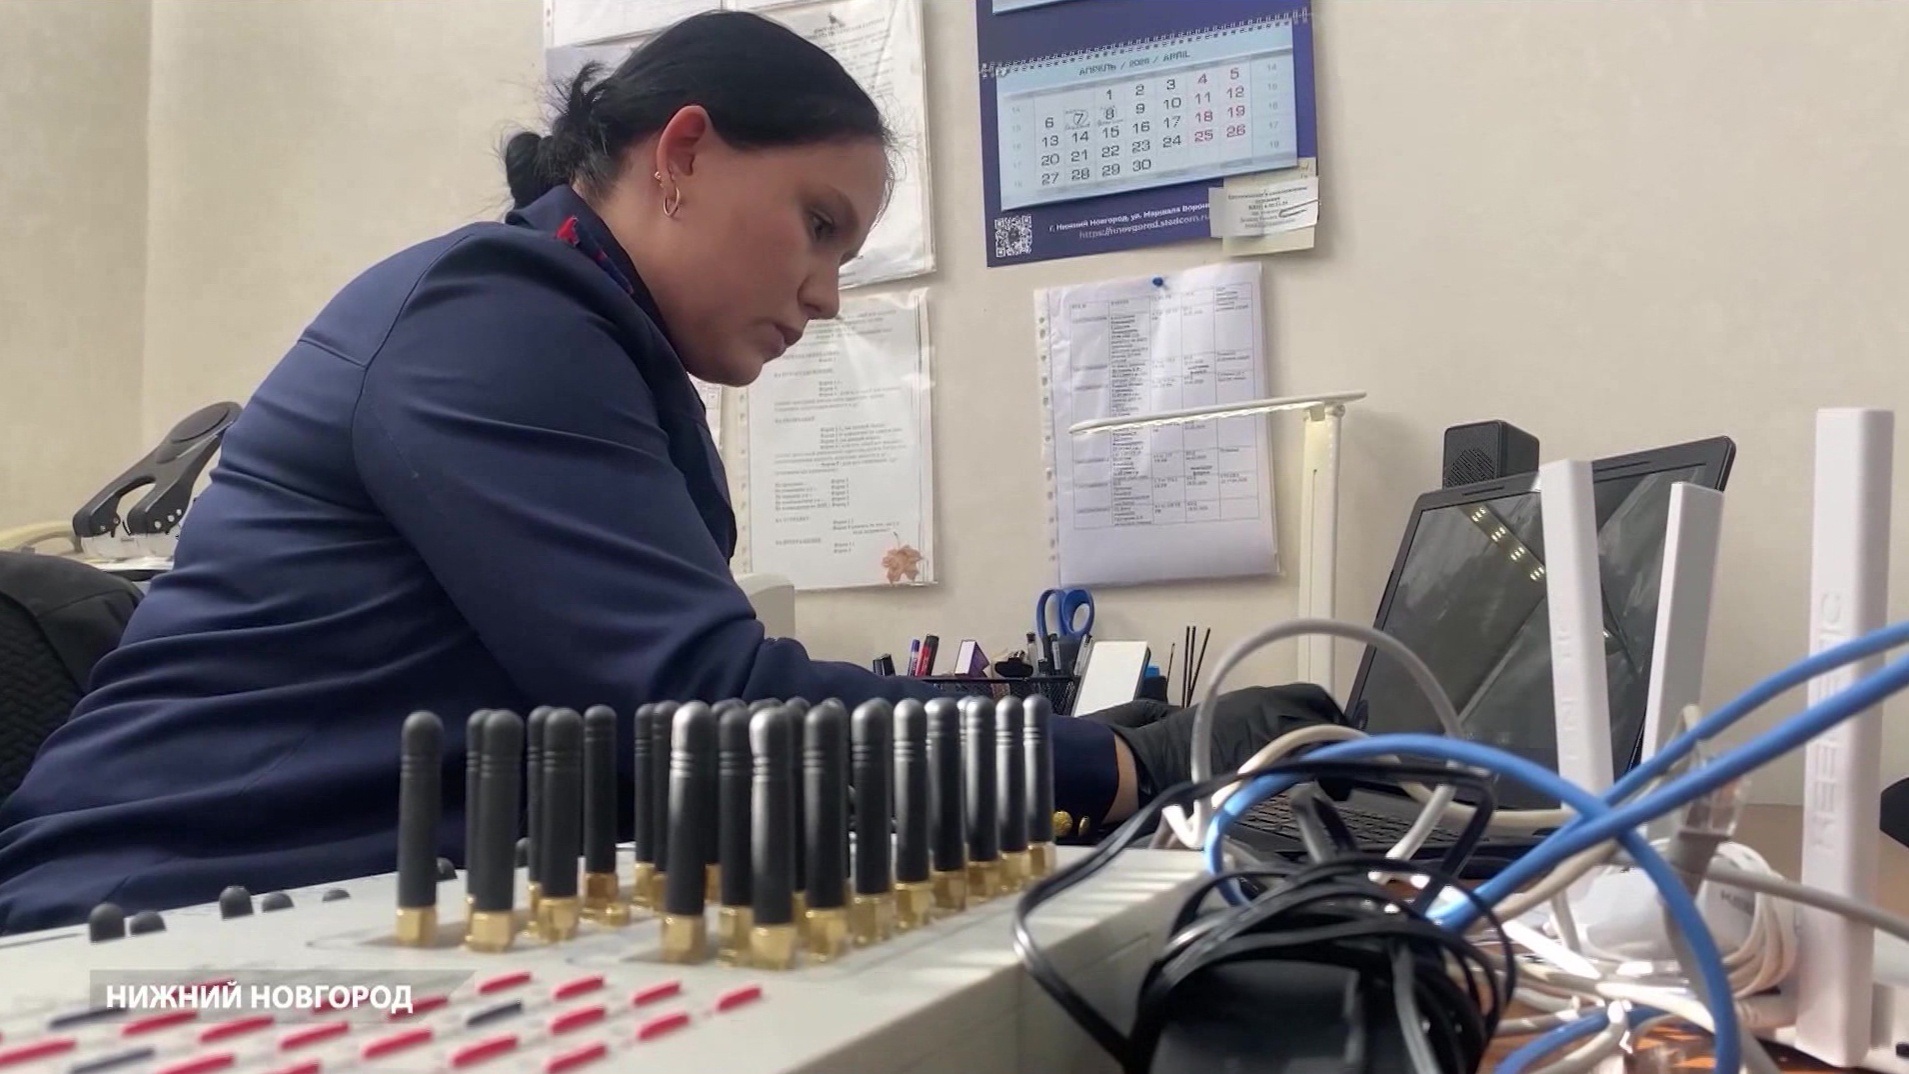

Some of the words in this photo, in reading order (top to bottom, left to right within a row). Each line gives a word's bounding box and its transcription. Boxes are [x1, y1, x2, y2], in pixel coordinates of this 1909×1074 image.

[1106, 89, 1112, 101] 1
[1135, 84, 1145, 96] 2
[1166, 79, 1176, 91] 3
[1198, 73, 1208, 85] 4
[1229, 67, 1240, 80] 5
[1045, 117, 1055, 129] 6
[1073, 113, 1084, 125] 7
[1105, 108, 1115, 120] 8
[1135, 103, 1145, 115] 9
[1163, 97, 1182, 110] 10
[1195, 92, 1211, 105] 11
[1226, 85, 1245, 99] 12
[1041, 153, 1060, 167] 20
[1070, 149, 1088, 163] 21
[1101, 144, 1120, 158] 22
[1131, 139, 1151, 154] 23
[1162, 134, 1182, 149] 24
[1194, 129, 1214, 143] 25
[1226, 123, 1246, 138] 26
[1042, 135, 1059, 148] 13
[1072, 131, 1089, 144] 14
[1102, 126, 1120, 139] 15
[1132, 121, 1151, 134] 16
[1163, 115, 1182, 129] 17
[1195, 110, 1214, 124] 18
[1227, 105, 1246, 118] 19
[1041, 172, 1059, 186] 27
[1071, 167, 1090, 181] 28
[1101, 163, 1121, 177] 29
[1132, 159, 1152, 172] 30
[1056, 219, 1088, 232] Нижний
[1143, 206, 1181, 219] Маршала
